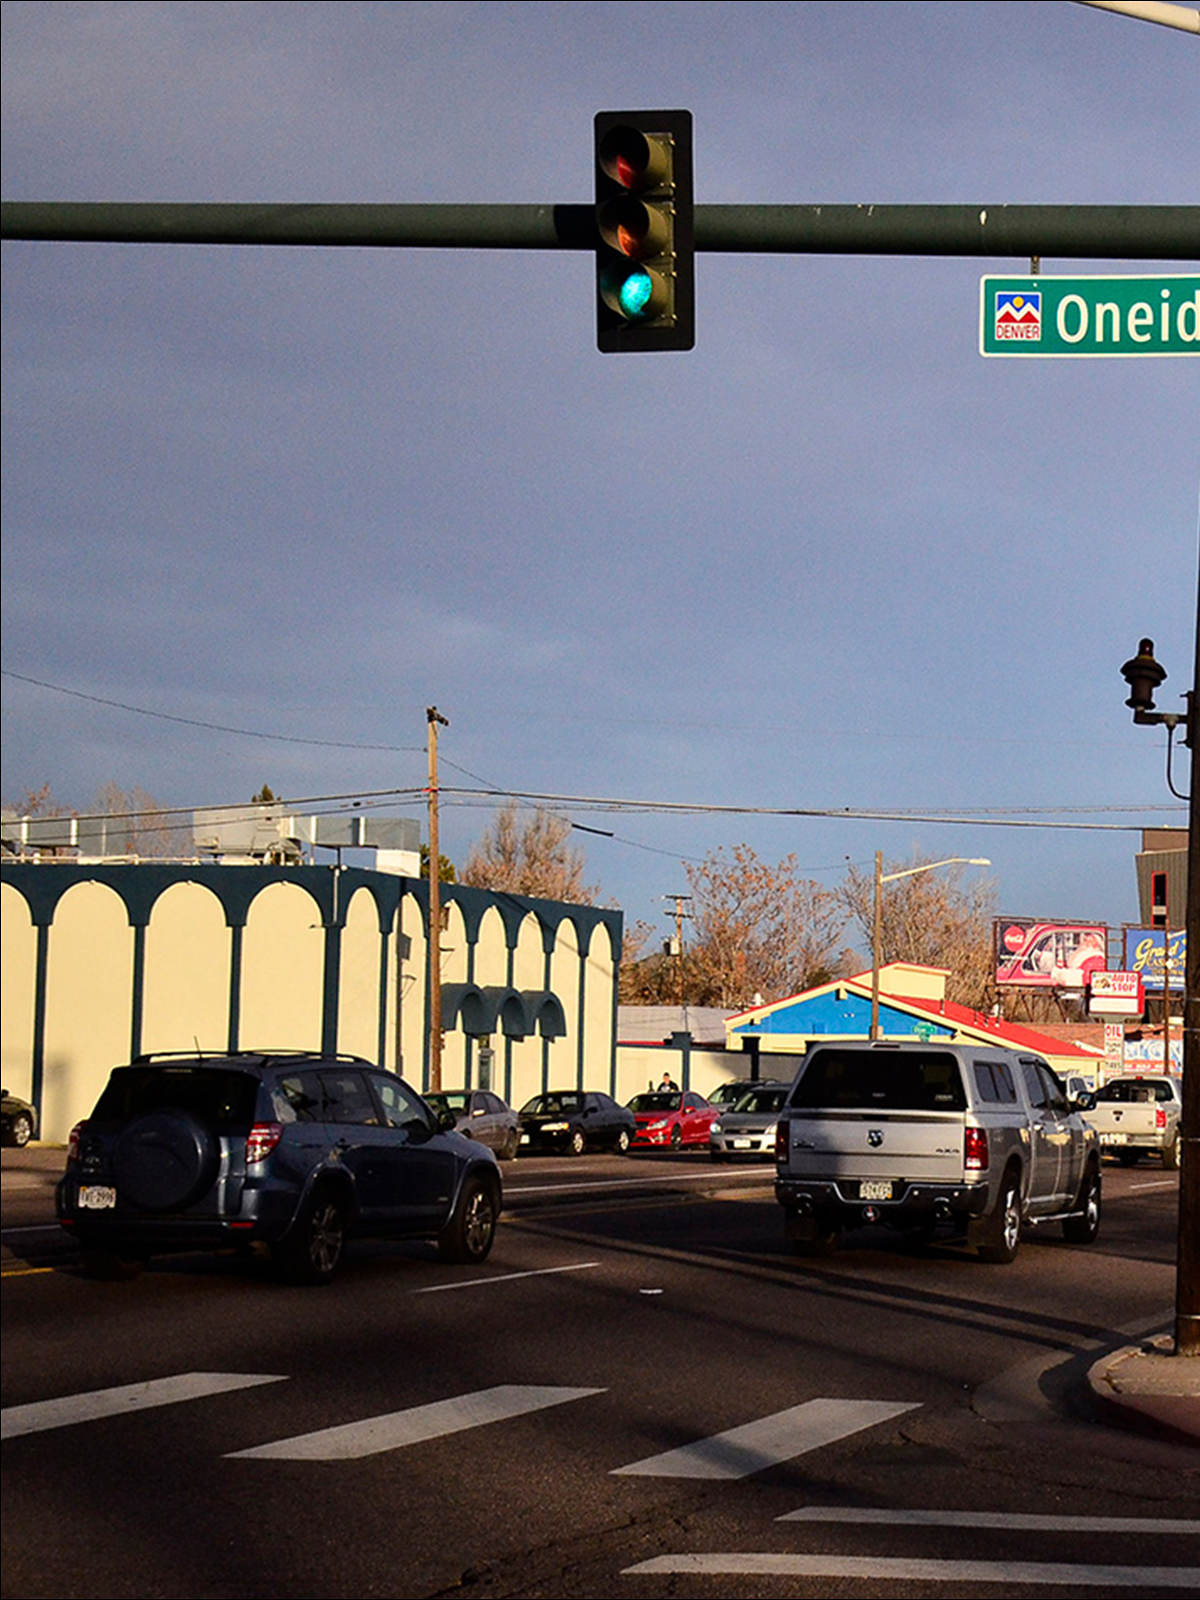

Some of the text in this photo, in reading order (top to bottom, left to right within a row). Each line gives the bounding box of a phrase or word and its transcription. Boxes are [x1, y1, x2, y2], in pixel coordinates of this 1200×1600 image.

[996, 324, 1040, 339] DENVER
[1111, 972, 1137, 982] AUTO
[1111, 983, 1136, 992] STOP
[1105, 1025, 1121, 1037] OIL
